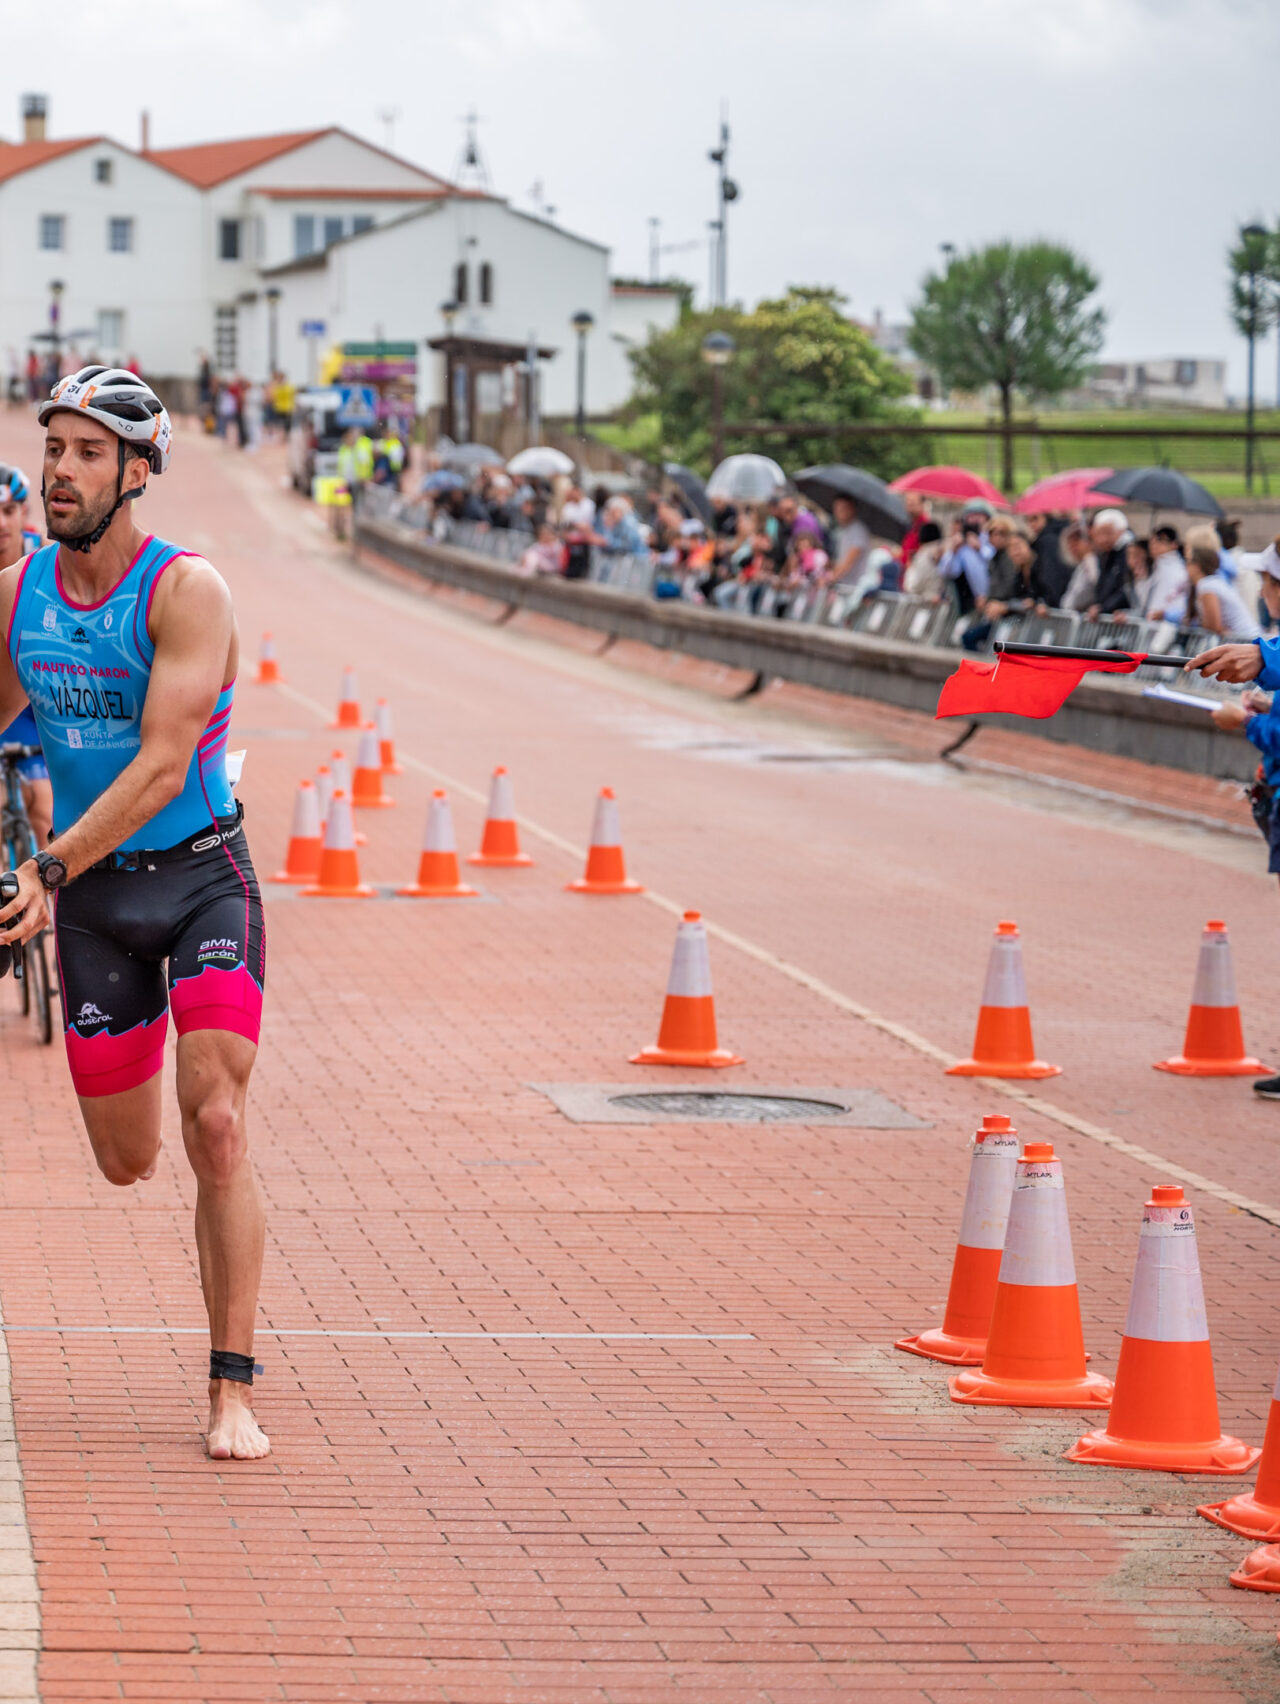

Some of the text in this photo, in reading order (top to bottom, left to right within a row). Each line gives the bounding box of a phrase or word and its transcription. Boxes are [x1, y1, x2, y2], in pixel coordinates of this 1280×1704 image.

[32, 660, 130, 679] NAUTICO NARON
[49, 680, 132, 720] VÁZQUEZ
[84, 731, 114, 740] XUNTA
[85, 740, 96, 748] DE
